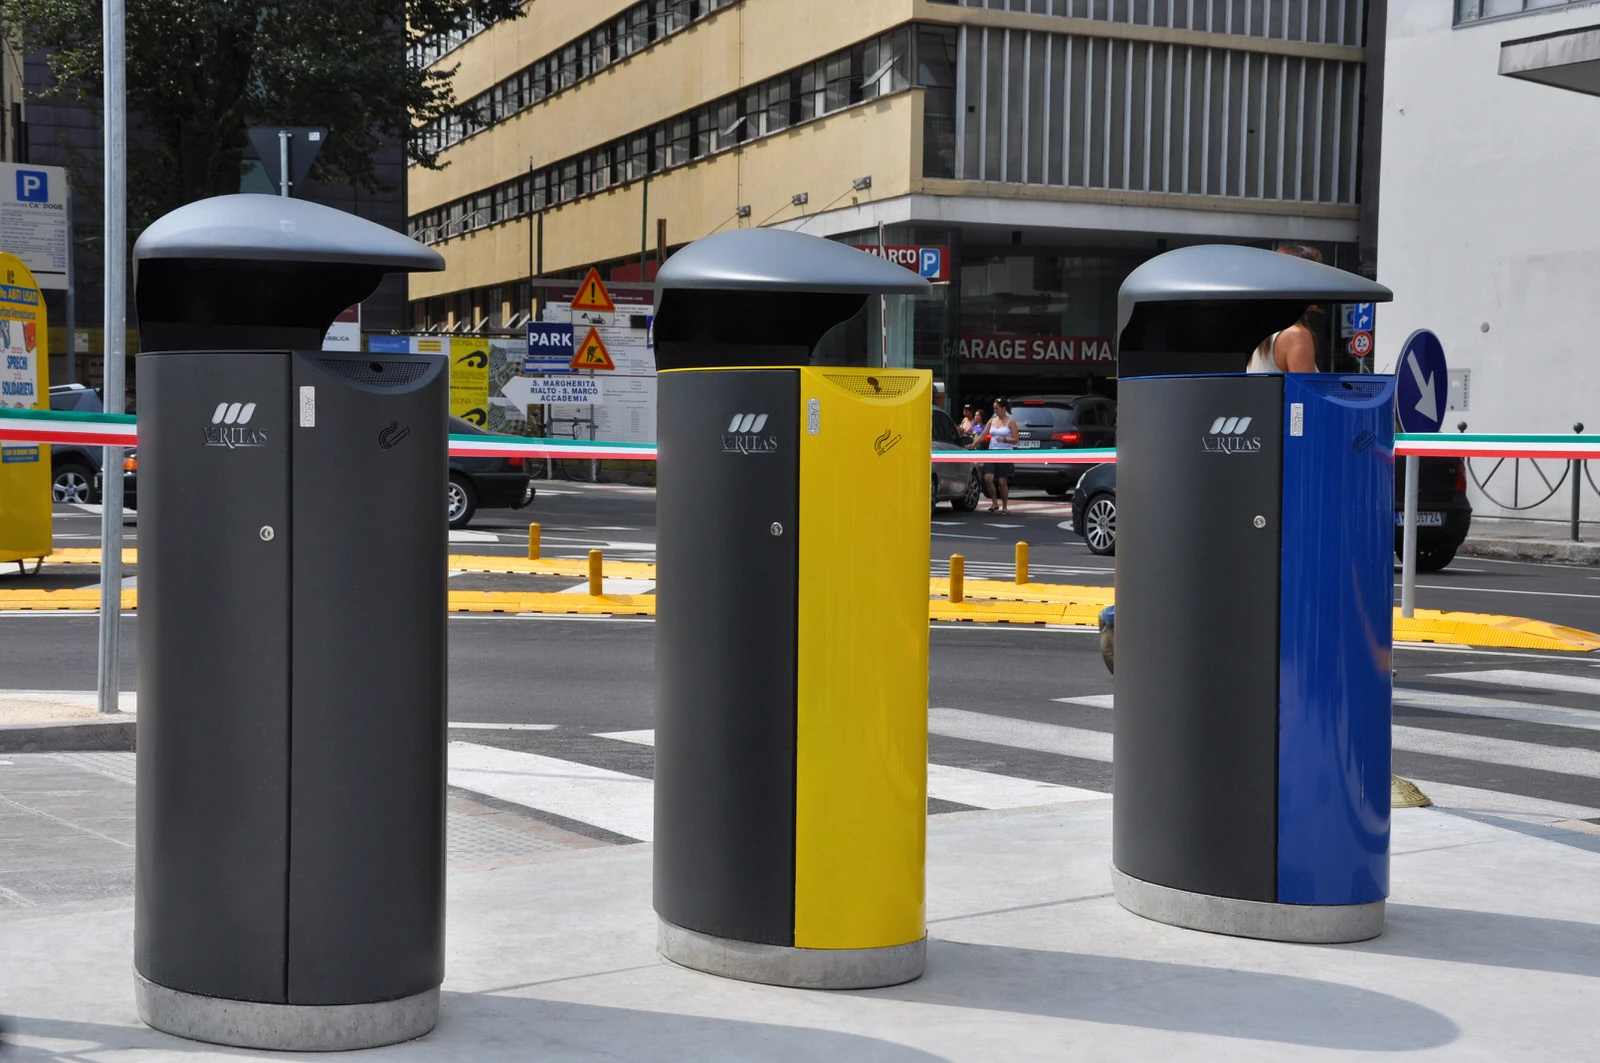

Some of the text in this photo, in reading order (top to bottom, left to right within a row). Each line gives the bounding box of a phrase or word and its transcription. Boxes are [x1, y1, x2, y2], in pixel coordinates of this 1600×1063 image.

[24, 175, 41, 197] P
[923, 252, 936, 271] P
[529, 332, 573, 346] PARK
[1032, 339, 1075, 360] SAN
[1081, 340, 1116, 361] MA
[202, 427, 267, 449] VERITAS
[721, 435, 777, 455] VERITAS
[1202, 437, 1261, 454] VERITAS
